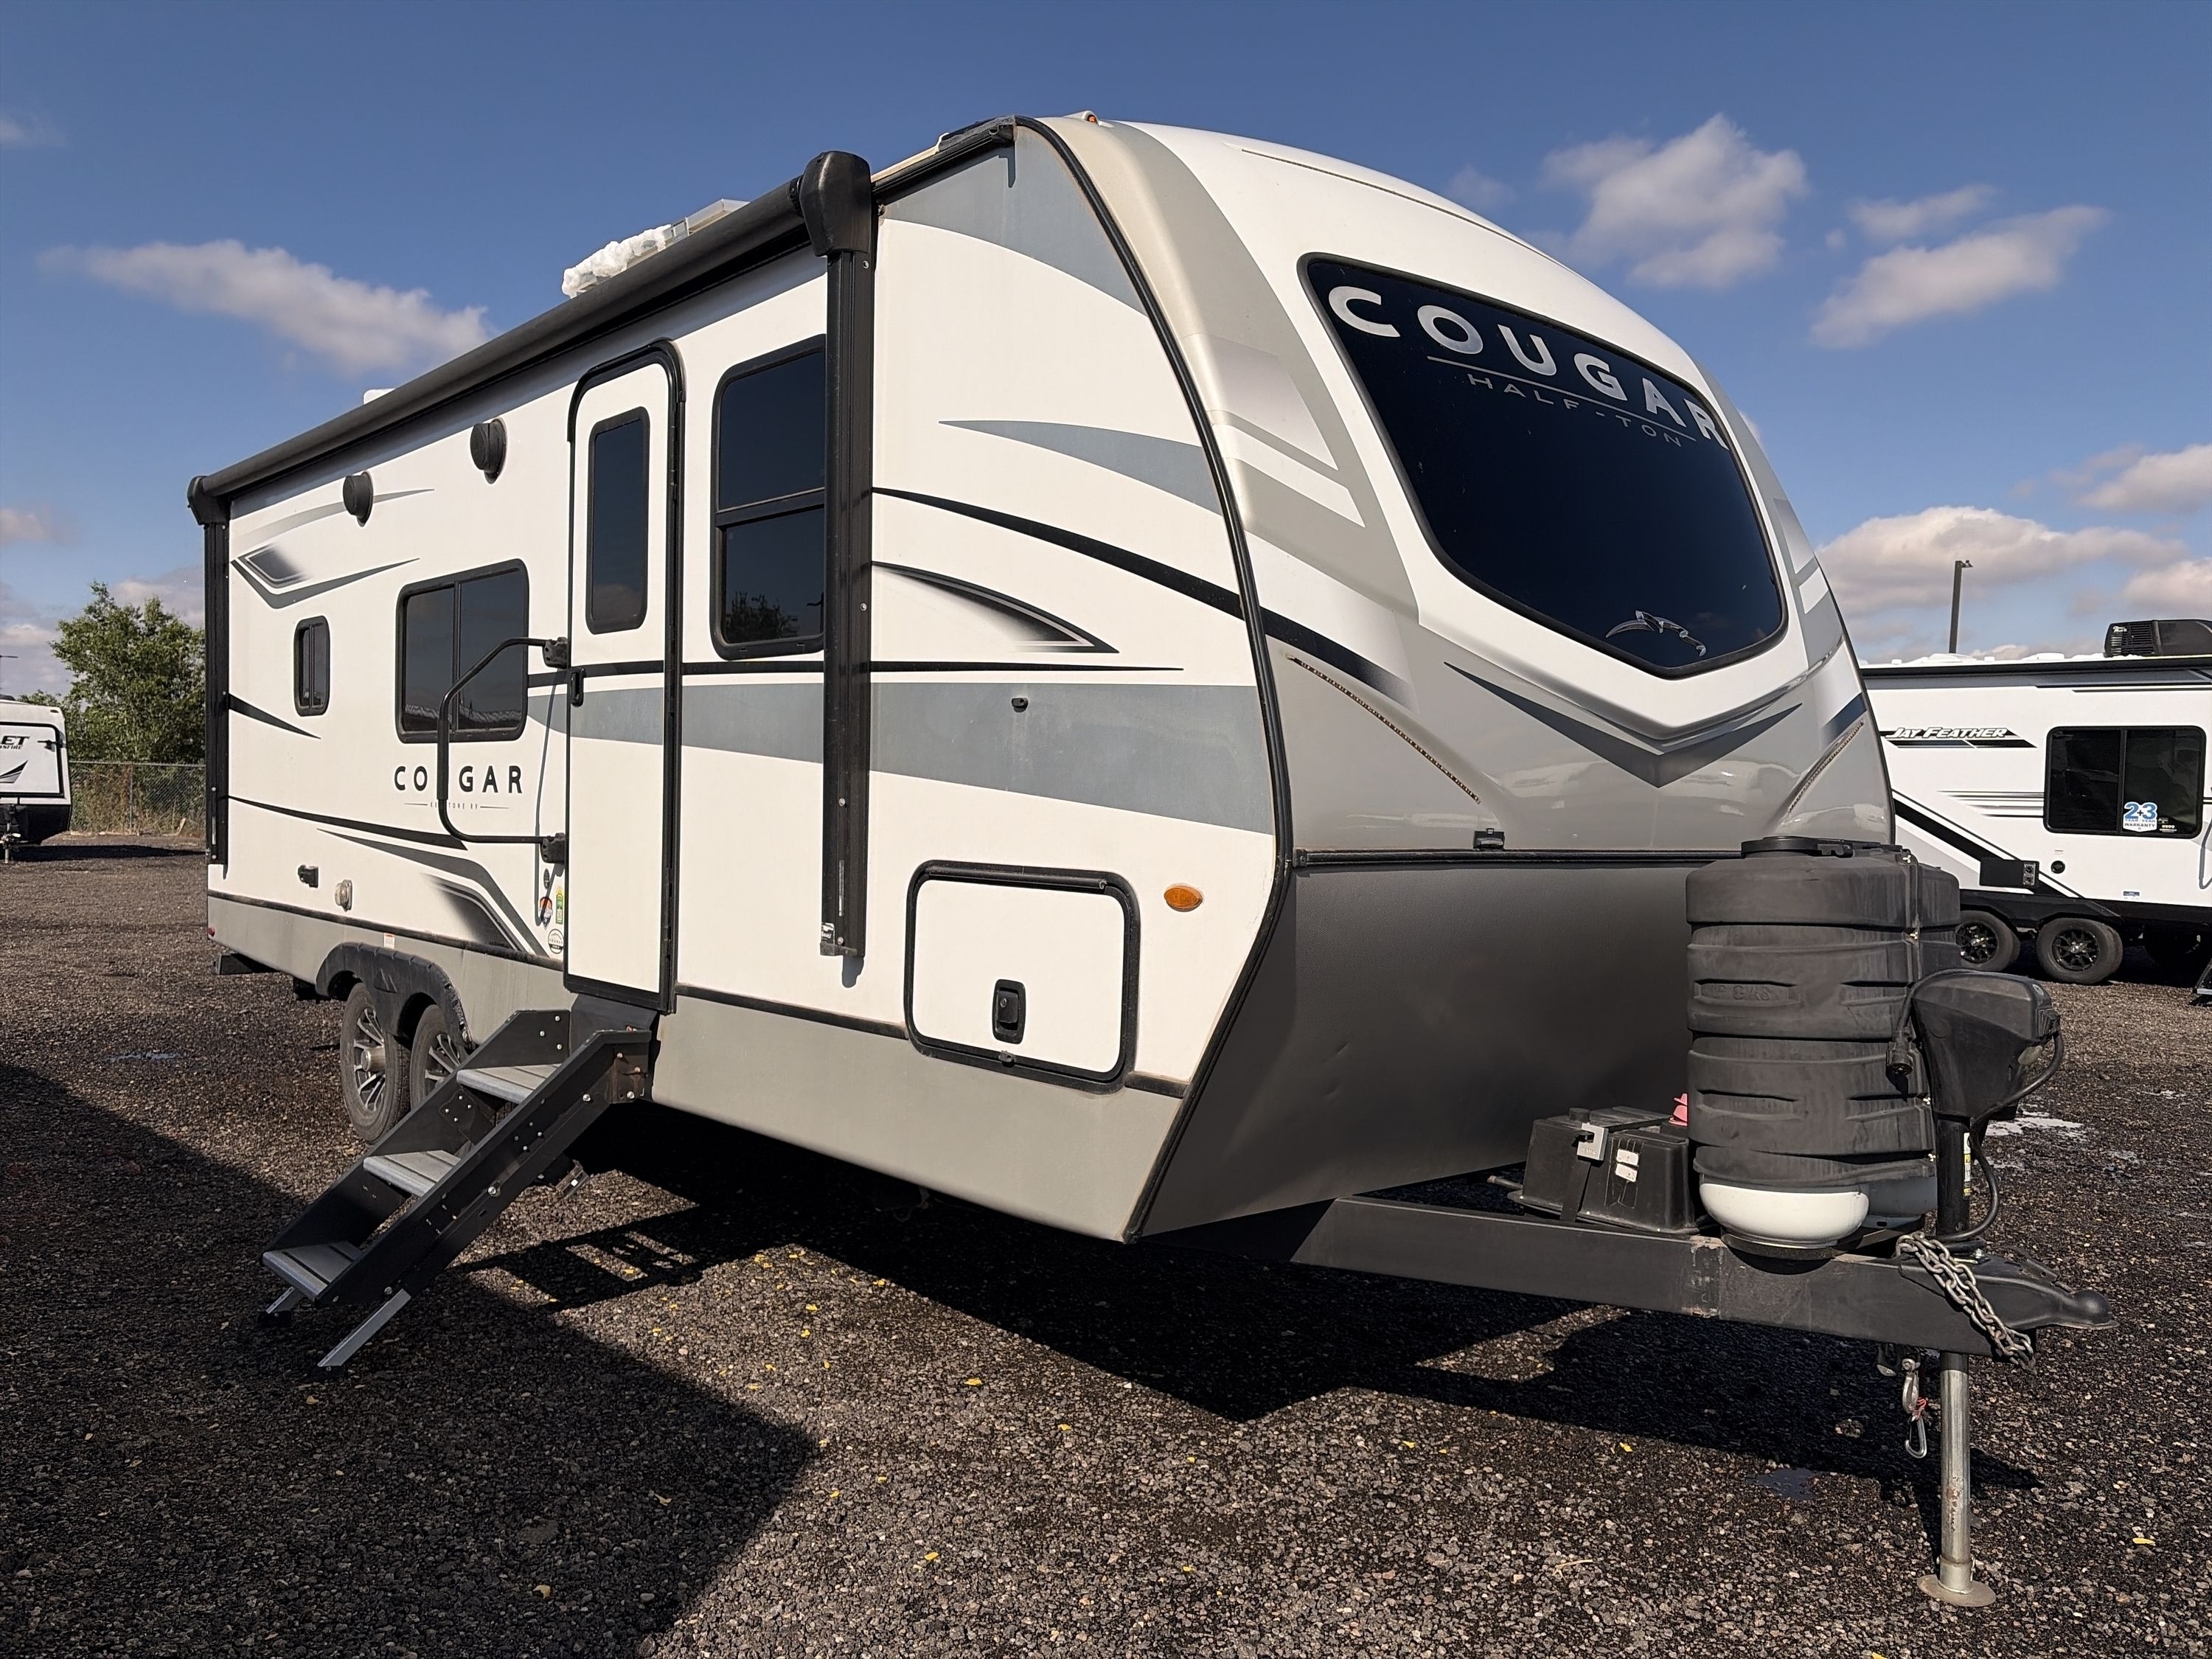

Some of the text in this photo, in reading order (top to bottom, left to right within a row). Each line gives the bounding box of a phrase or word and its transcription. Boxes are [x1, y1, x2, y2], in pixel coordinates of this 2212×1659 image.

[1328, 285, 1730, 451] COUGAR
[1467, 373, 1682, 448] HALF-TON
[0, 735, 30, 745] ET
[1885, 726, 2007, 738] JAY FEATHER
[394, 765, 523, 794] COGAR
[430, 798, 465, 810] KETONE
